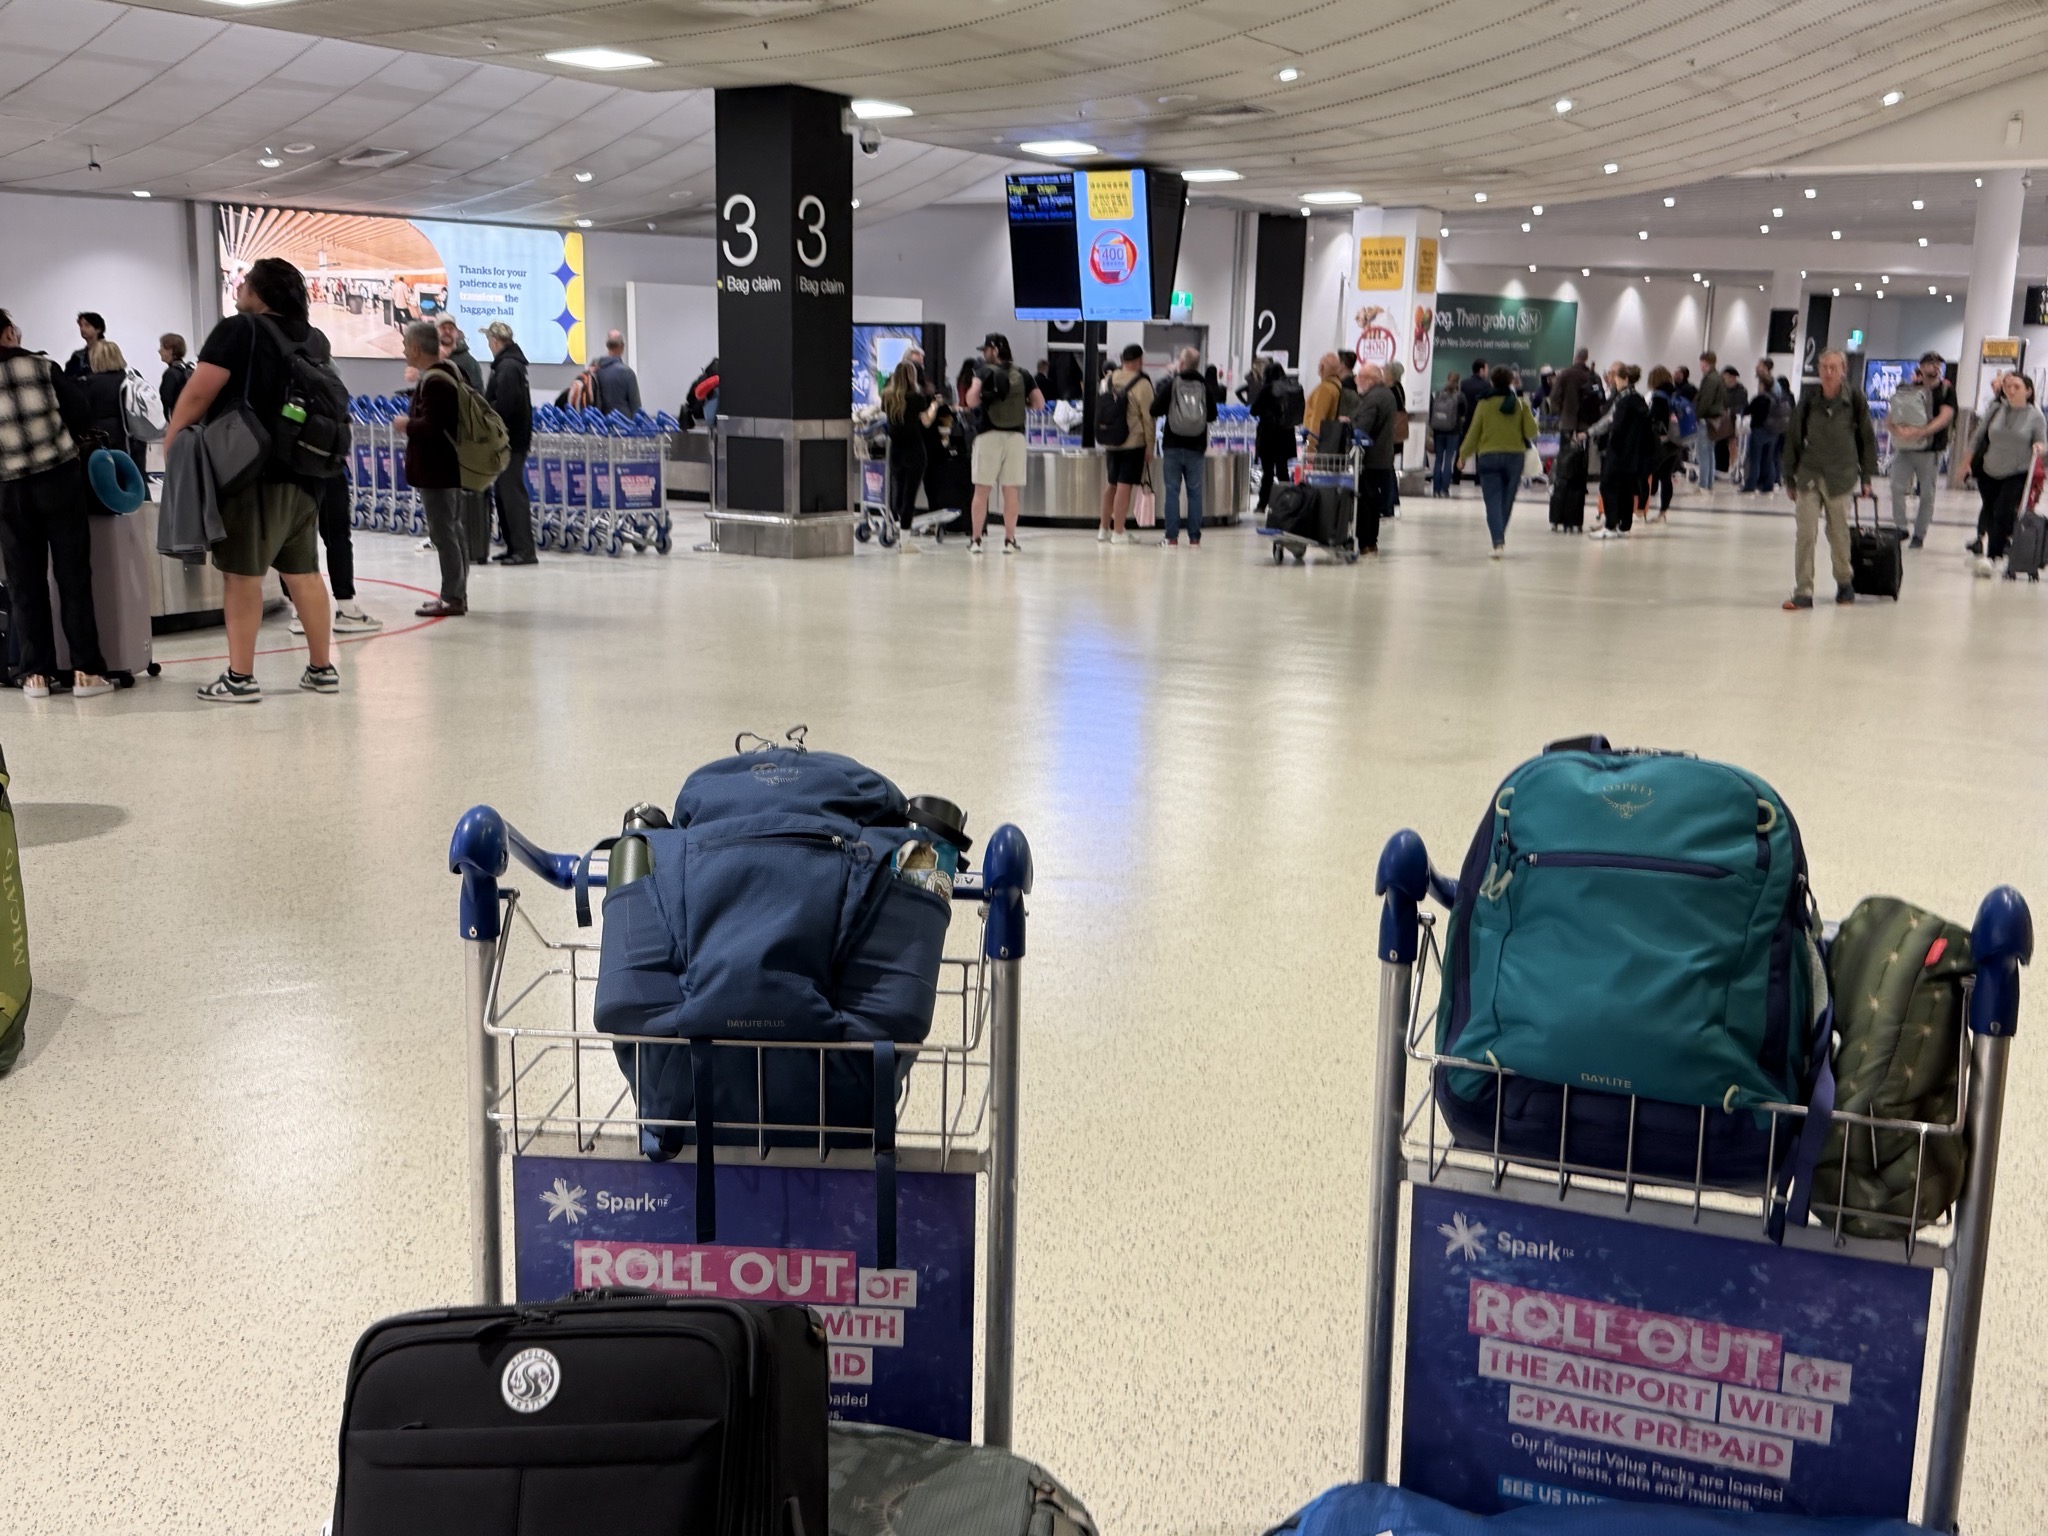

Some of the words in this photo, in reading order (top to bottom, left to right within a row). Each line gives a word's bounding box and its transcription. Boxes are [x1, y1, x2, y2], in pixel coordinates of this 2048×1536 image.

[723, 194, 758, 267] 3
[797, 195, 827, 268] 3
[1101, 248, 1125, 260] 400
[459, 265, 492, 276] Thanks
[493, 267, 506, 277] for
[507, 269, 527, 279] your
[459, 279, 497, 289] patience
[509, 282, 522, 290] we
[727, 275, 749, 295] Bag
[752, 276, 781, 292] claim
[459, 291, 504, 303] transform
[504, 294, 519, 302] the
[799, 276, 819, 297] Bag
[820, 278, 845, 295] claim
[460, 305, 496, 316] baggage
[497, 306, 514, 316] hall
[1456, 307, 1480, 328] Then
[1482, 309, 1506, 332] grab
[1508, 316, 1515, 330] a
[1256, 309, 1276, 358] 2
[1804, 336, 1815, 372] 2
[727, 1020, 762, 1028] DAYLITE
[763, 1020, 786, 1028] PLUS
[1580, 1072, 1632, 1089] DAYLITE
[596, 1190, 656, 1214] Spark
[1497, 1230, 1561, 1262] Spark
[581, 1246, 718, 1293] ROLL
[729, 1251, 849, 1298] OUT
[865, 1274, 910, 1300] OF
[1475, 1286, 1622, 1357] ROLL
[1637, 1318, 1774, 1382] OUT
[1790, 1362, 1843, 1393] OF
[829, 1392, 868, 1407] aded
[1485, 1346, 1548, 1381] THE
[1556, 1361, 1711, 1412] AIRPORT
[1728, 1393, 1823, 1435] WITH
[1515, 1393, 1625, 1438] SPARK
[1634, 1417, 1785, 1468] PREPAID
[1511, 1432, 1540, 1456] Our
[1544, 1438, 1601, 1465] Prepaid
[1605, 1451, 1647, 1474] Value
[1652, 1461, 1695, 1484] Packs
[1700, 1474, 1724, 1490] are
[1728, 1476, 1784, 1502] loaded
[1536, 1456, 1567, 1474] with
[1572, 1462, 1611, 1486] texts,
[1616, 1471, 1650, 1492] data
[1654, 1482, 1685, 1500] and
[1502, 1478, 1534, 1499] SEE
[1538, 1485, 1562, 1505] US
